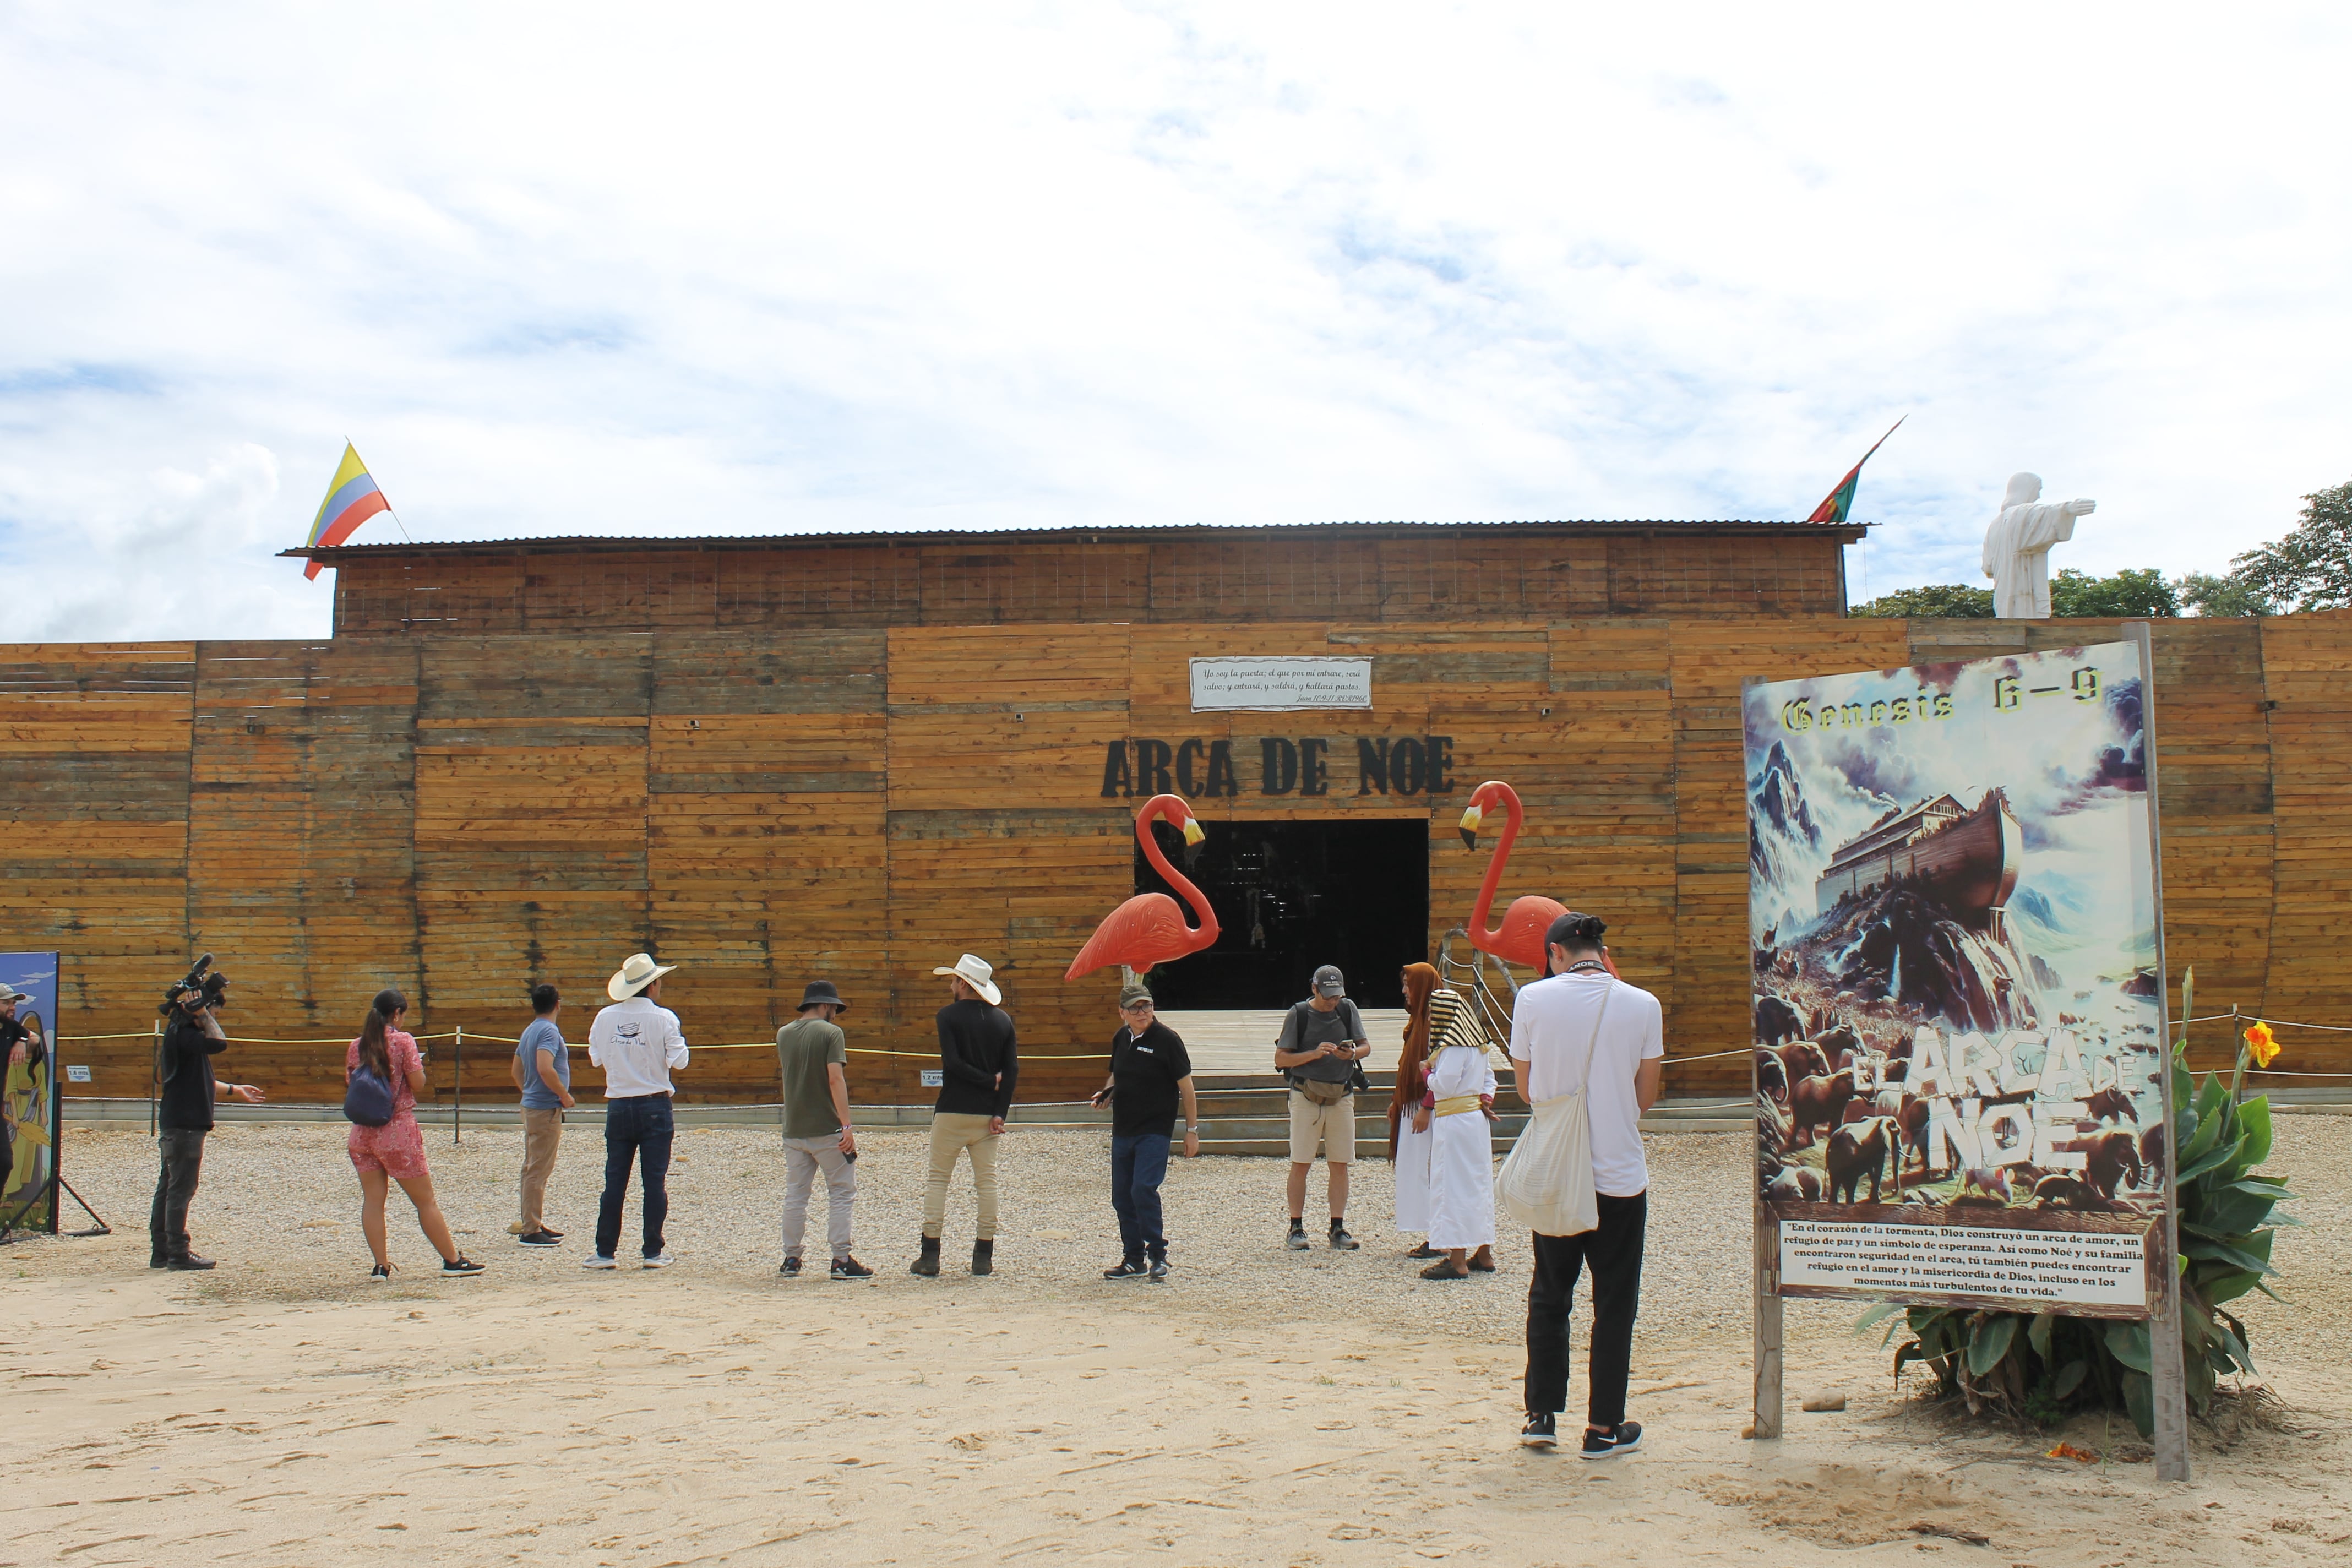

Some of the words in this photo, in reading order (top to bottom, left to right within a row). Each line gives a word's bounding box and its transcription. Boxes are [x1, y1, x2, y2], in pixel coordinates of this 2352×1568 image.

[1203, 669, 1213, 679] Yo
[1240, 669, 1266, 679] puerta;
[1317, 669, 1344, 678] entrare,
[1203, 682, 1226, 690] salvo;
[1234, 682, 1262, 690] entrará,
[1271, 682, 1297, 690] saldrá,
[1335, 683, 1361, 692] pastos.
[1297, 694, 1312, 703] Juan
[1781, 685, 1955, 736] Genesis
[1099, 738, 1238, 798] ARCA
[1260, 738, 1329, 796] DE
[1357, 736, 1454, 796] NOE
[1852, 1056, 1903, 1091] EL
[1903, 1025, 2094, 1098] ARCA
[2093, 1054, 2140, 1093] DE
[1927, 1096, 2089, 1170] NOE
[1787, 1223, 1804, 1232] "En
[1817, 1224, 1858, 1233] corazón
[1885, 1227, 1938, 1238] tormenta,
[1941, 1228, 1964, 1237] Dios
[1967, 1231, 2022, 1241] construyó
[2069, 1235, 2082, 1243] de
[1784, 1236, 1820, 1246] refugio
[1924, 1241, 1936, 1249] de
[1939, 1243, 1995, 1253] esperanza.
[2018, 1247, 2048, 1255] como
[2050, 1247, 2072, 1256] Noé
[2075, 1250, 2082, 1258] y
[2100, 1250, 2143, 1260] familia
[1794, 1249, 1856, 1259] encontraron
[1858, 1252, 1909, 1261] seguridad
[1939, 1257, 1965, 1265] arca,
[1968, 1256, 1980, 1265] tú
[1982, 1257, 2028, 1267] también
[2030, 1260, 2069, 1270] puedes
[2072, 1264, 2131, 1273] encontrar
[1807, 1262, 1843, 1272] refugio
[1910, 1266, 1920, 1275] la
[1923, 1267, 1990, 1279] misericordia
[1993, 1271, 2006, 1280] de
[2008, 1271, 2036, 1283] Dios,
[2039, 1273, 2079, 1284] incluso
[2099, 1277, 2116, 1286] los
[1854, 1278, 1907, 1287] momentos
[1910, 1280, 1930, 1288] más
[1933, 1281, 1997, 1293] turbulentos
[2000, 1285, 2013, 1293] de
[2030, 1287, 2062, 1297] vida."
